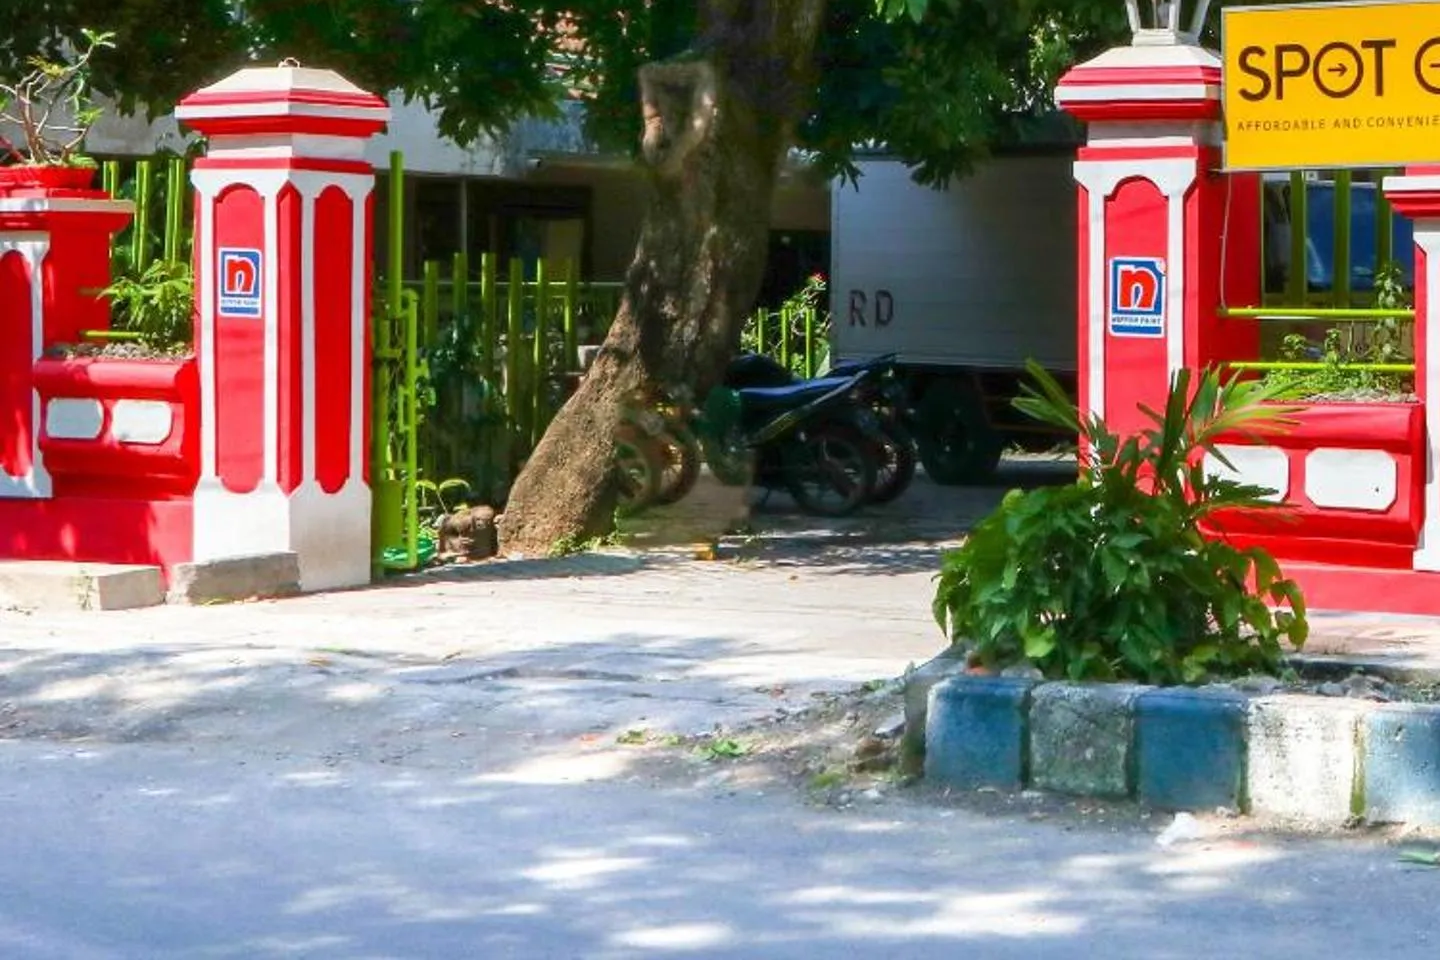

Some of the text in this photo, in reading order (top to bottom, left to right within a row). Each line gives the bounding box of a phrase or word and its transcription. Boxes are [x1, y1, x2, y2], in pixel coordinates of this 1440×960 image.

[1238, 38, 1397, 102] SPOT
[1236, 119, 1325, 132] AFFORDABLE
[1333, 117, 1362, 130] AND
